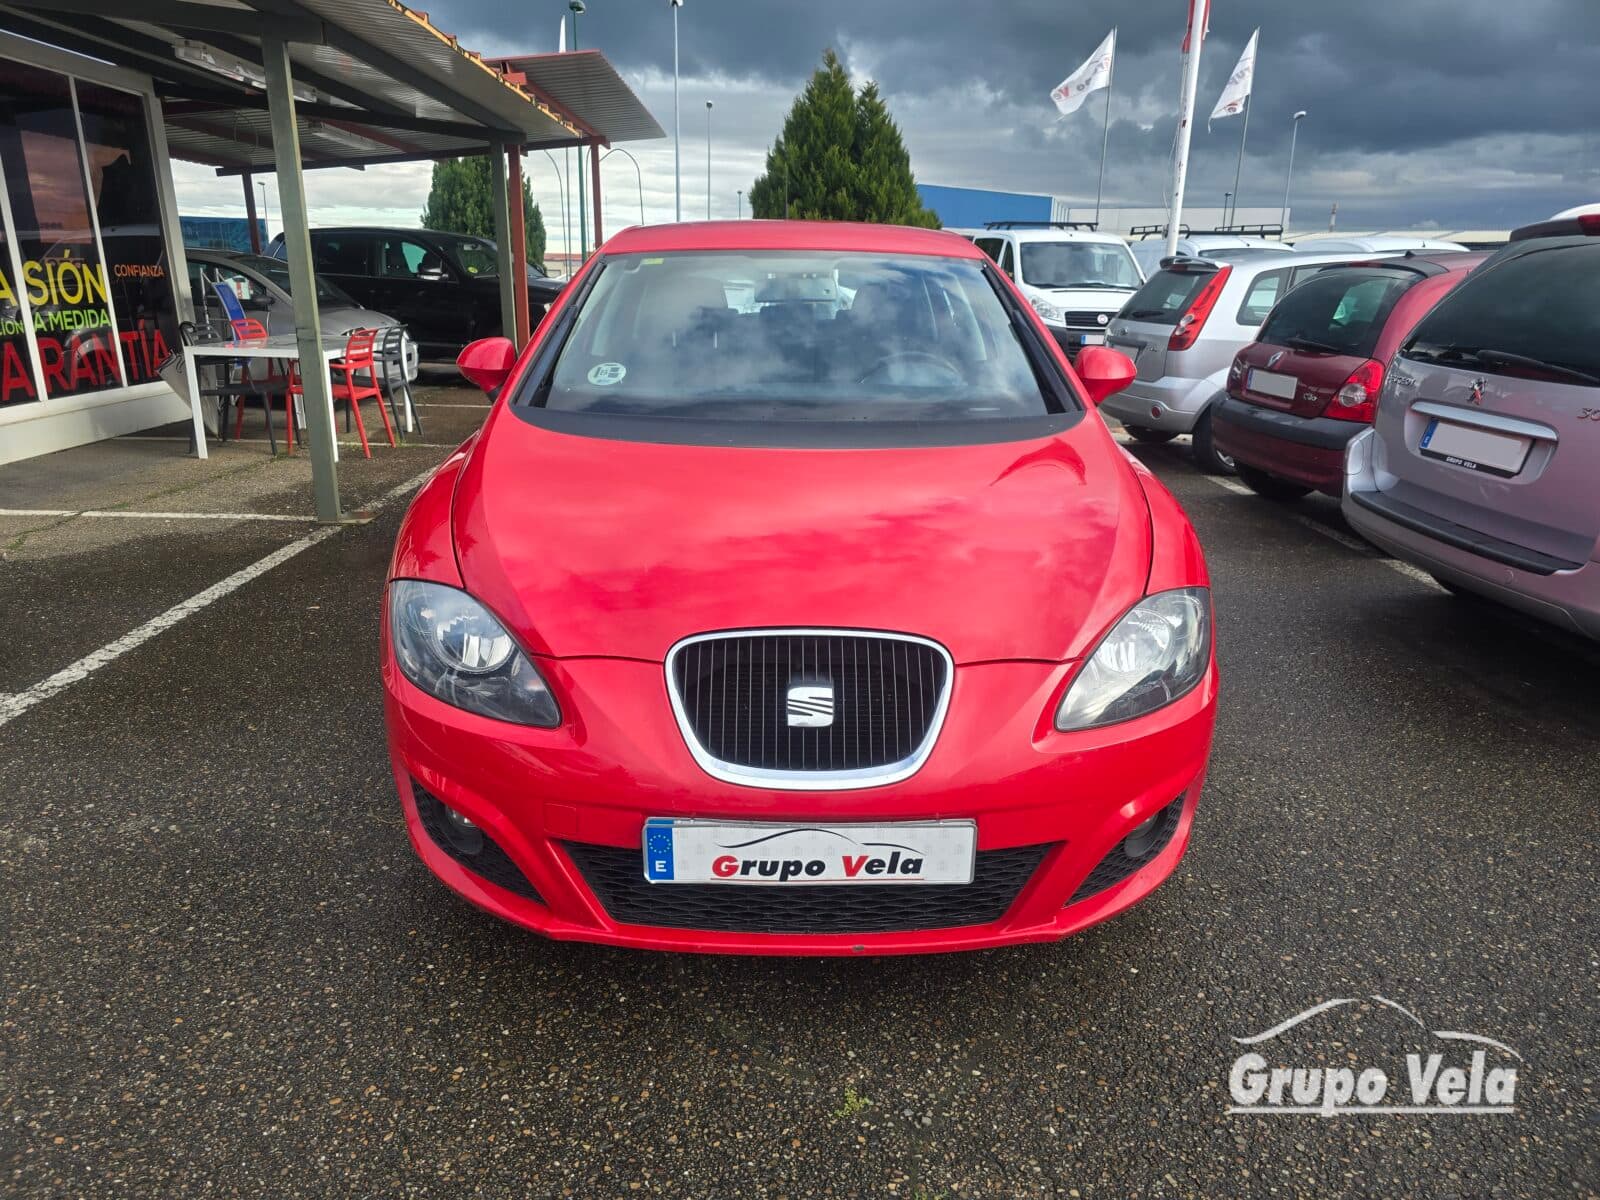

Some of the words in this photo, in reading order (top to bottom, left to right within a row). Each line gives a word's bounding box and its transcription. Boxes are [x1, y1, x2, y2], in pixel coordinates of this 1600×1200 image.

[114, 264, 165, 277] CONFIANZA
[34, 311, 48, 332] A
[48, 309, 112, 330] MEDIDA
[655, 860, 667, 872] E
[711, 855, 826, 882] Grupo
[842, 852, 923, 877] Vela
